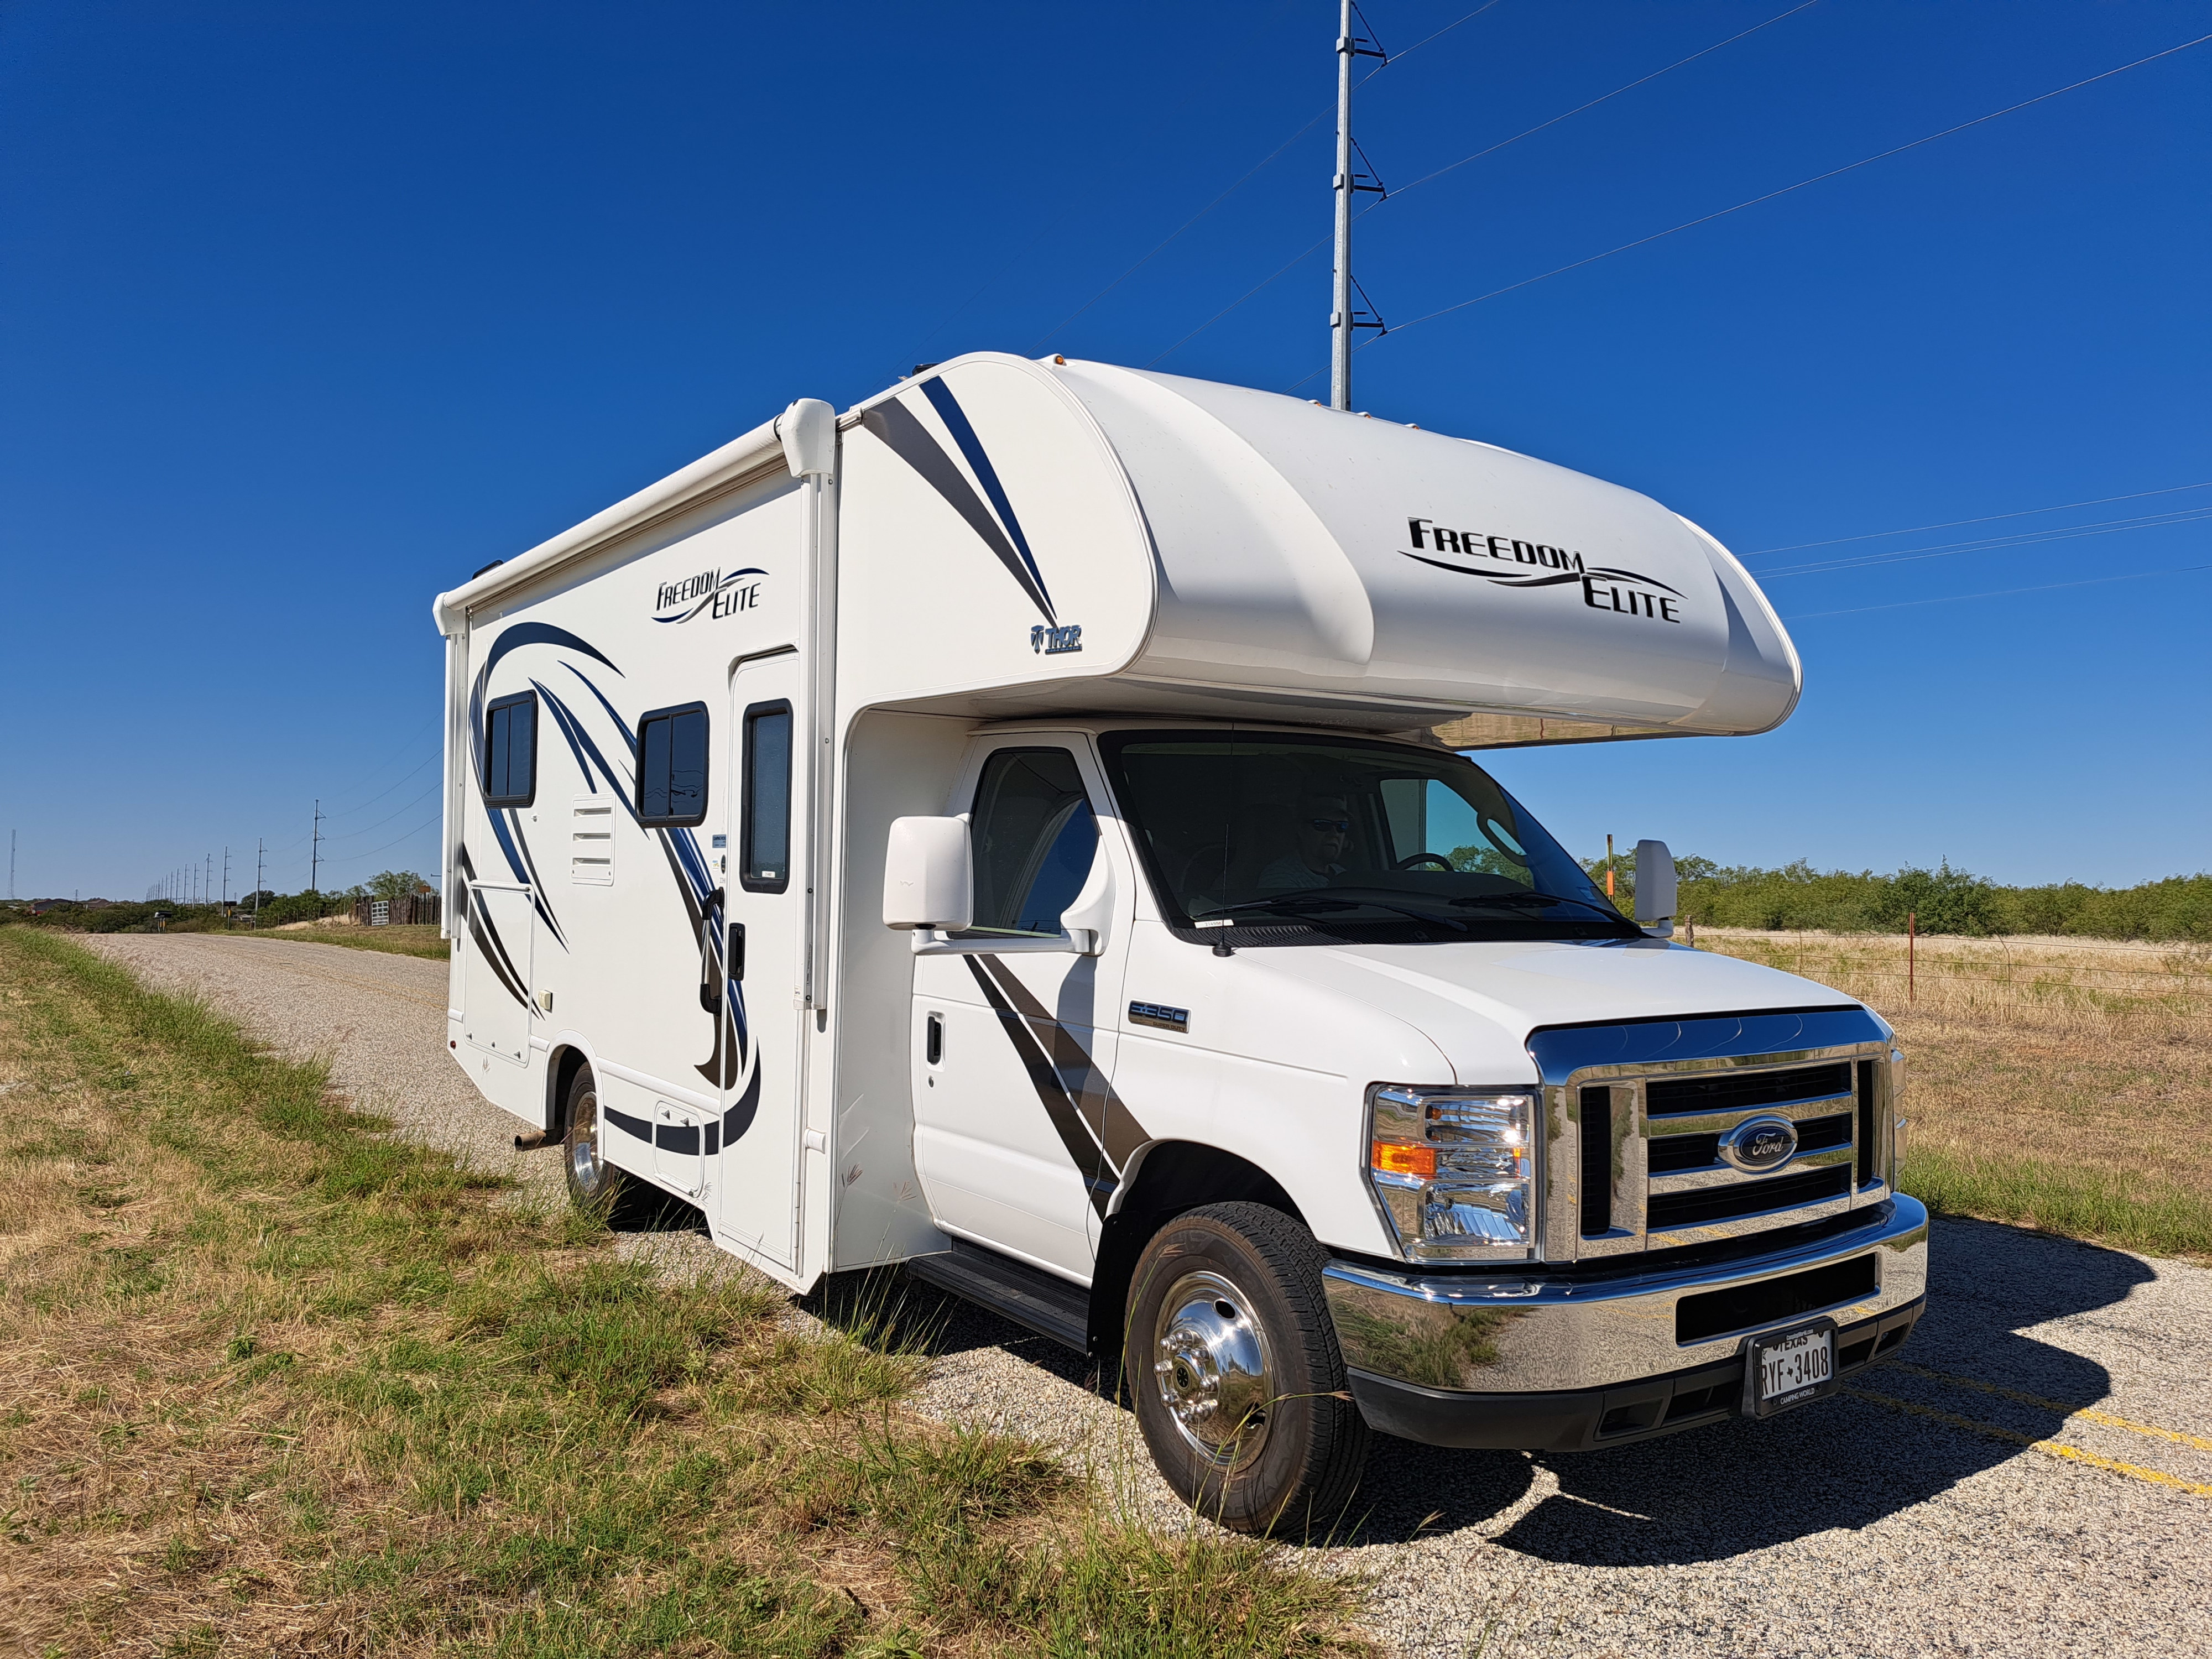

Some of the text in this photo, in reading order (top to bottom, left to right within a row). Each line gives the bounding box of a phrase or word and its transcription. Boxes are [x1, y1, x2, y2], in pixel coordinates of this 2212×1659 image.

[1407, 517, 1586, 574] FREEDOM
[656, 566, 721, 612] FREEDOM
[712, 582, 761, 620] ELITE
[1580, 575, 1681, 624] ELITE
[1045, 625, 1082, 648] THOR
[1752, 1132, 1784, 1156] Ford
[1794, 1346, 1828, 1384] 3408
[1780, 1387, 1815, 1405] CAMPING WORLD
